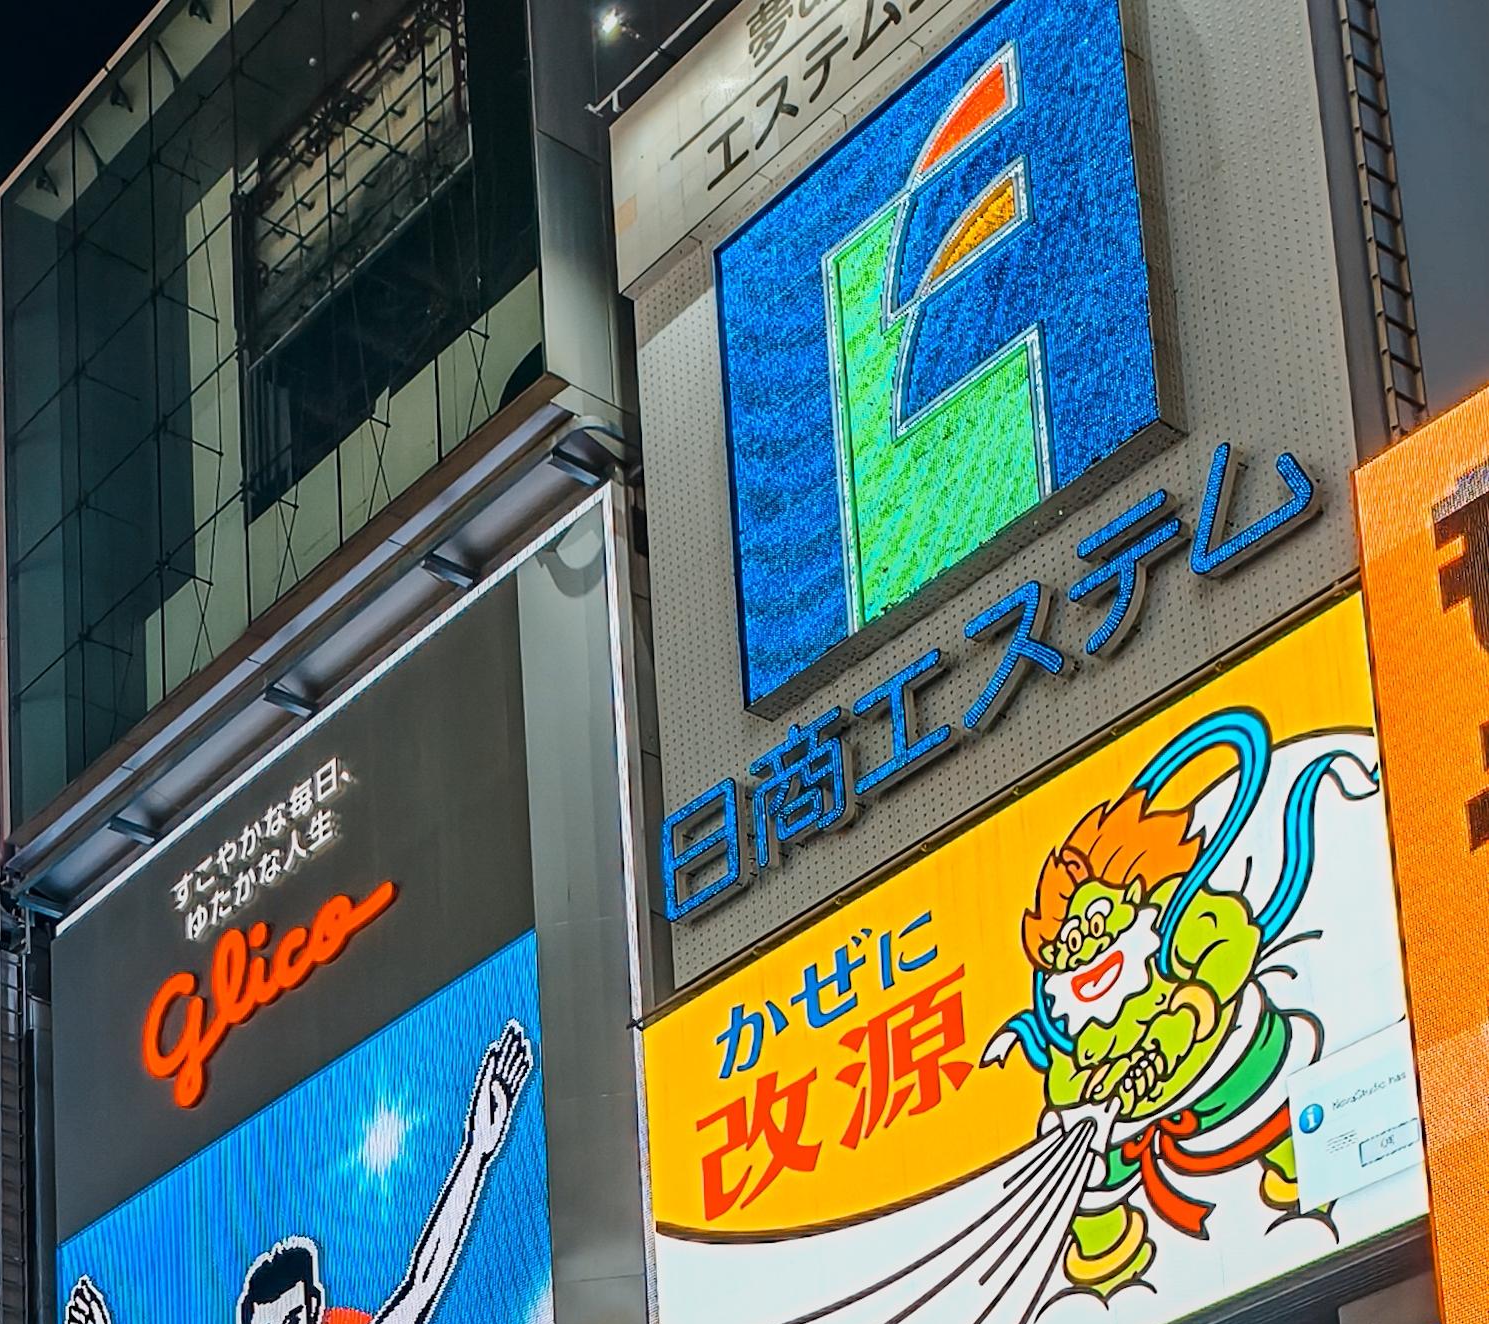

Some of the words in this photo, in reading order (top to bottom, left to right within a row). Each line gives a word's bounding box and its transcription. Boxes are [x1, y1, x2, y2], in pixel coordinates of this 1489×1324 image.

[663, 443, 1316, 921] 日商エステム
[170, 757, 351, 909] すこやかな毎日、
[186, 810, 335, 940] ゆたかな人生
[143, 880, 399, 1108] Glico
[696, 963, 974, 1221] 改源
[716, 910, 940, 1080] かぜに
